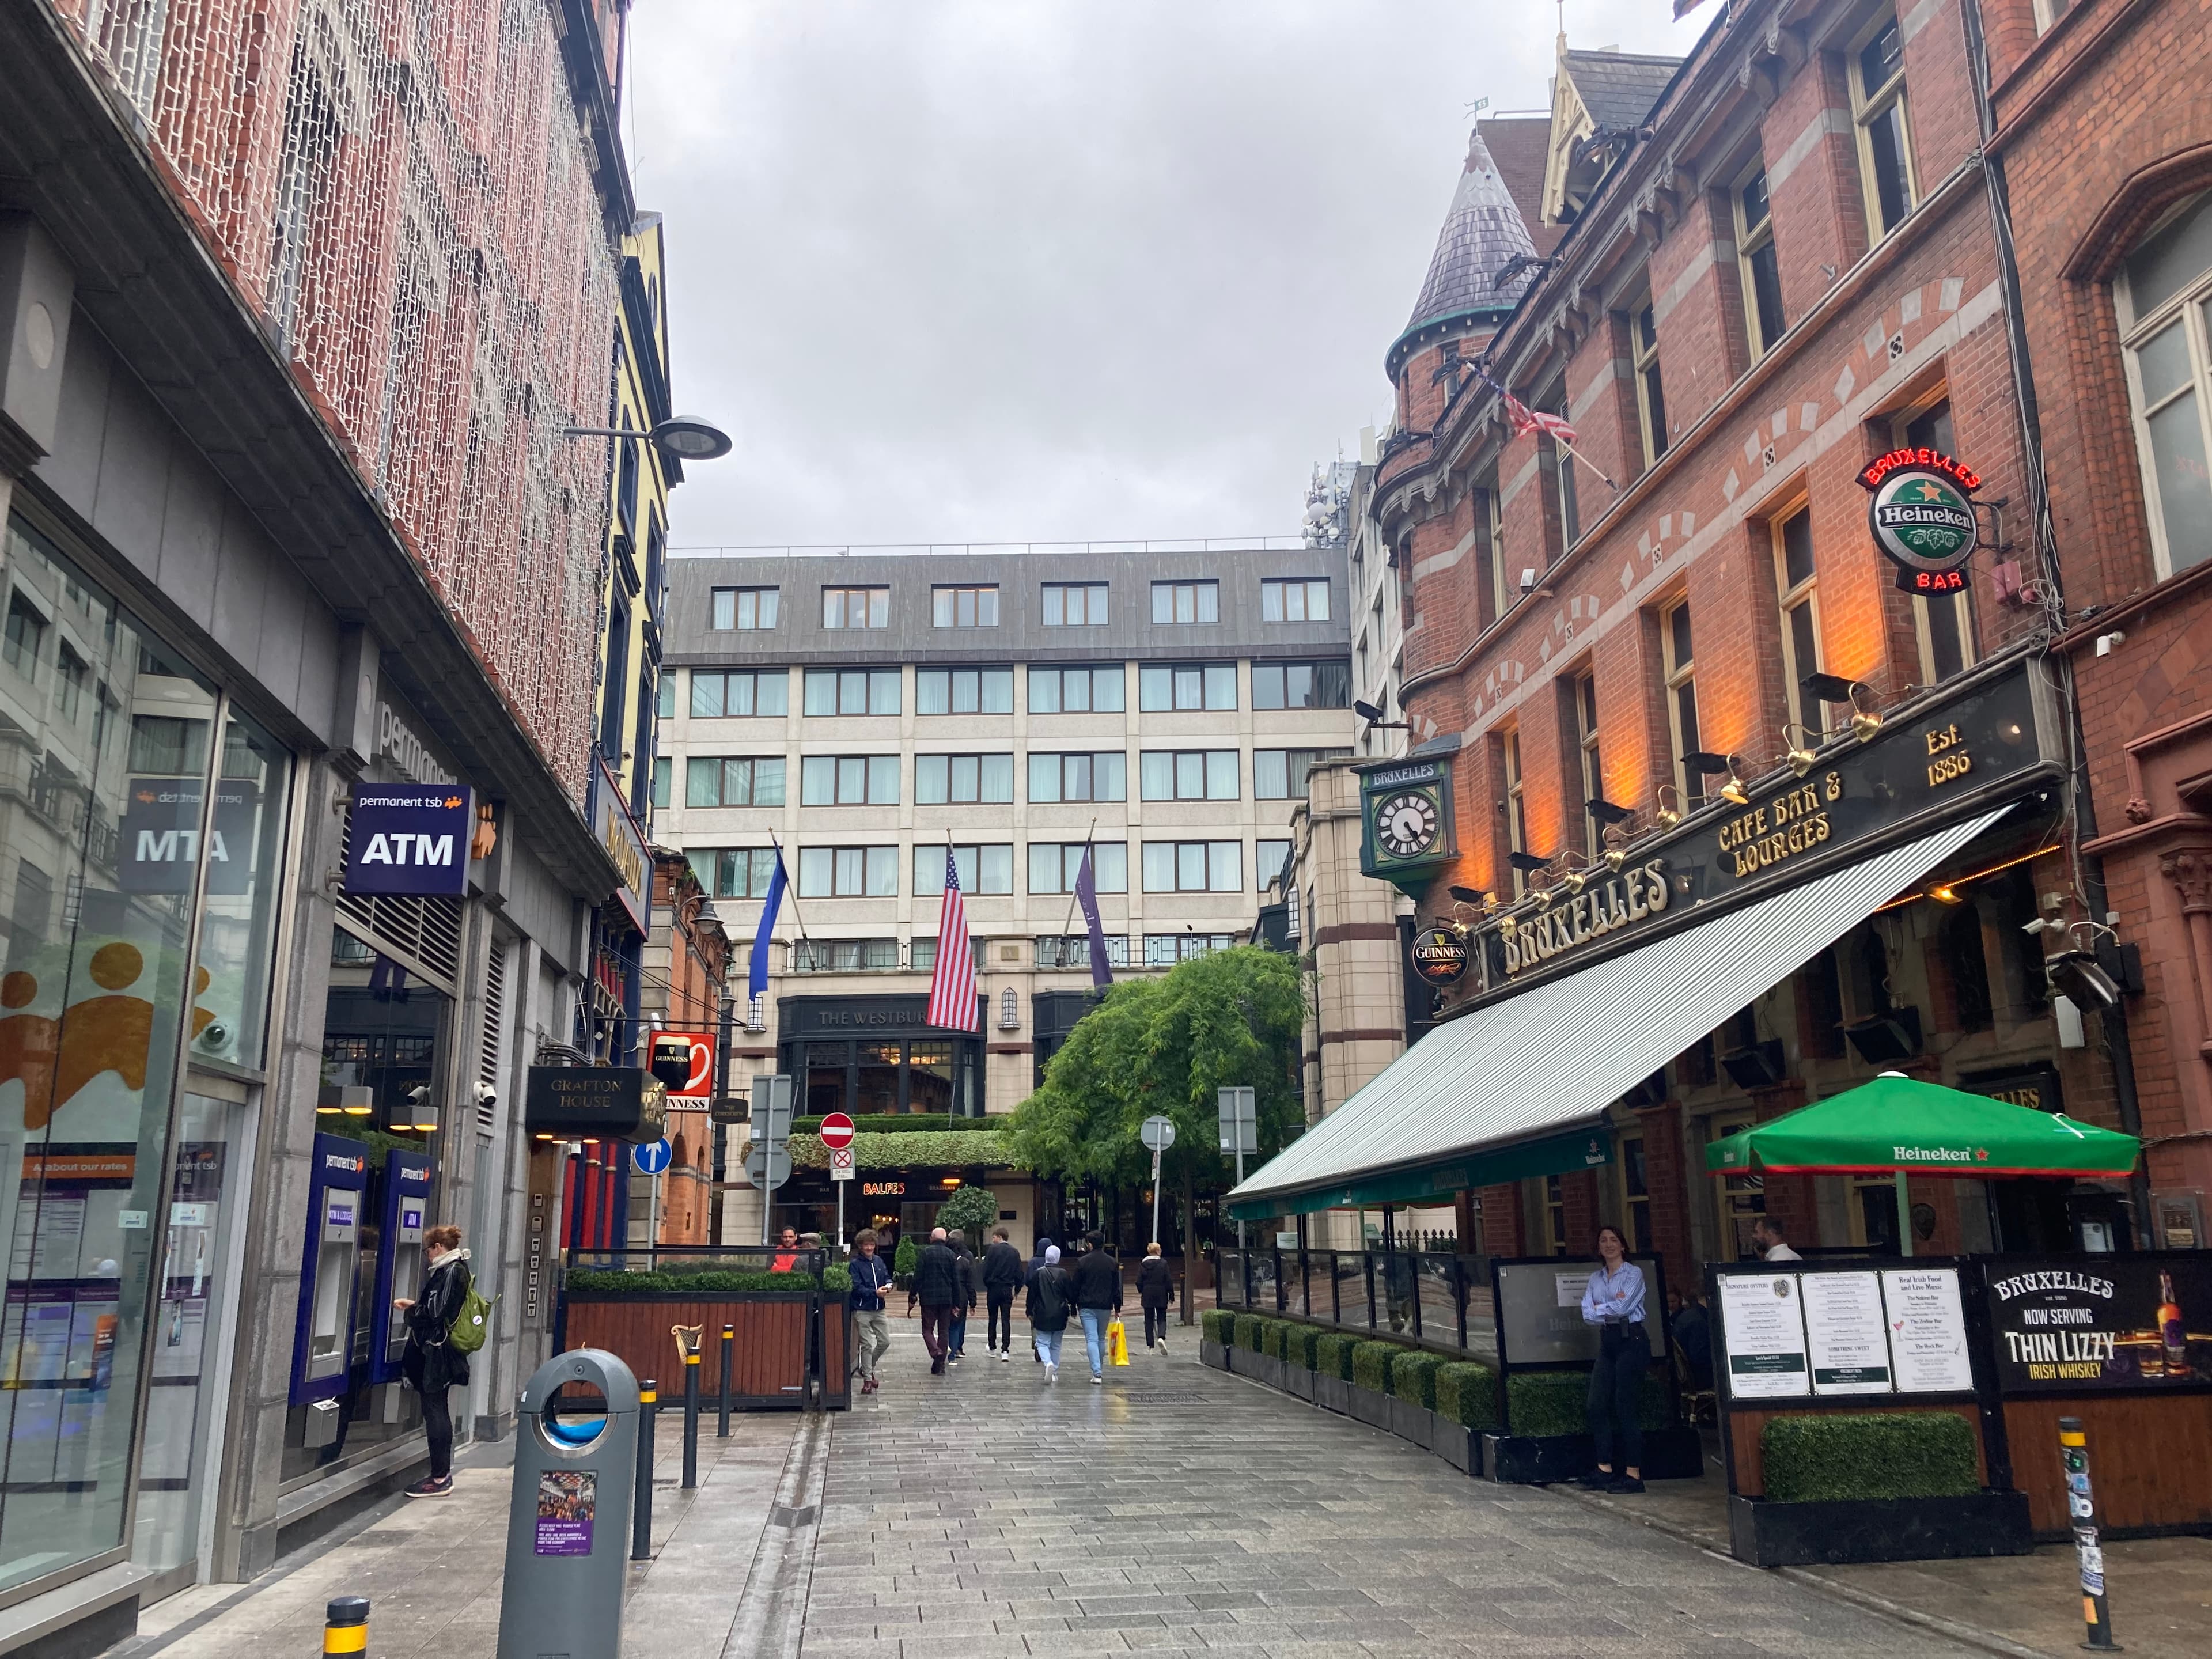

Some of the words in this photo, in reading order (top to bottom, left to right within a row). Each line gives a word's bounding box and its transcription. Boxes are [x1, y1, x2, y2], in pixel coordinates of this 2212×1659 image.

[1865, 448, 1982, 488] BRUXELLES
[1883, 506, 1972, 529] Heineken
[1916, 573, 1962, 590] BAR
[1925, 723, 1964, 756] Est.
[1373, 764, 1434, 785] BRUXELLES
[1927, 750, 1972, 787] 1886
[359, 797, 422, 808] permanent
[425, 797, 442, 808] tsb
[1718, 808, 1770, 851] CAFE
[1772, 783, 1820, 827] BAR
[1825, 771, 1842, 802] &
[361, 833, 454, 866] ATM
[1734, 812, 1831, 878] LOUNGES
[1501, 858, 1668, 974] BRUXELLES
[1415, 946, 1466, 959] GUINNESS
[819, 1010, 849, 1025] THE
[853, 1010, 928, 1024] WESTBUR
[655, 1055, 688, 1063] GUINNESS
[551, 1080, 623, 1092] GRAFTON
[559, 1096, 611, 1108] HOUSE
[665, 1098, 706, 1109] INNESS
[1892, 1146, 1971, 1161] Heineken
[45, 1162, 78, 1172] about
[101, 1162, 127, 1171] rates
[326, 1154, 351, 1171] permanent
[400, 1167, 419, 1180] permanent
[863, 1183, 905, 1195] BALFES
[408, 1213, 416, 1226] ATM
[1994, 1271, 2115, 1301] BRUXELLES
[2024, 1309, 2048, 1325] NOW
[2051, 1308, 2093, 1325] SERVING
[2005, 1331, 2060, 1363] THIN
[2059, 1330, 2116, 1362] LIZZY
[2028, 1363, 2056, 1380] IRISH
[2058, 1362, 2101, 1378] WHISKEY
